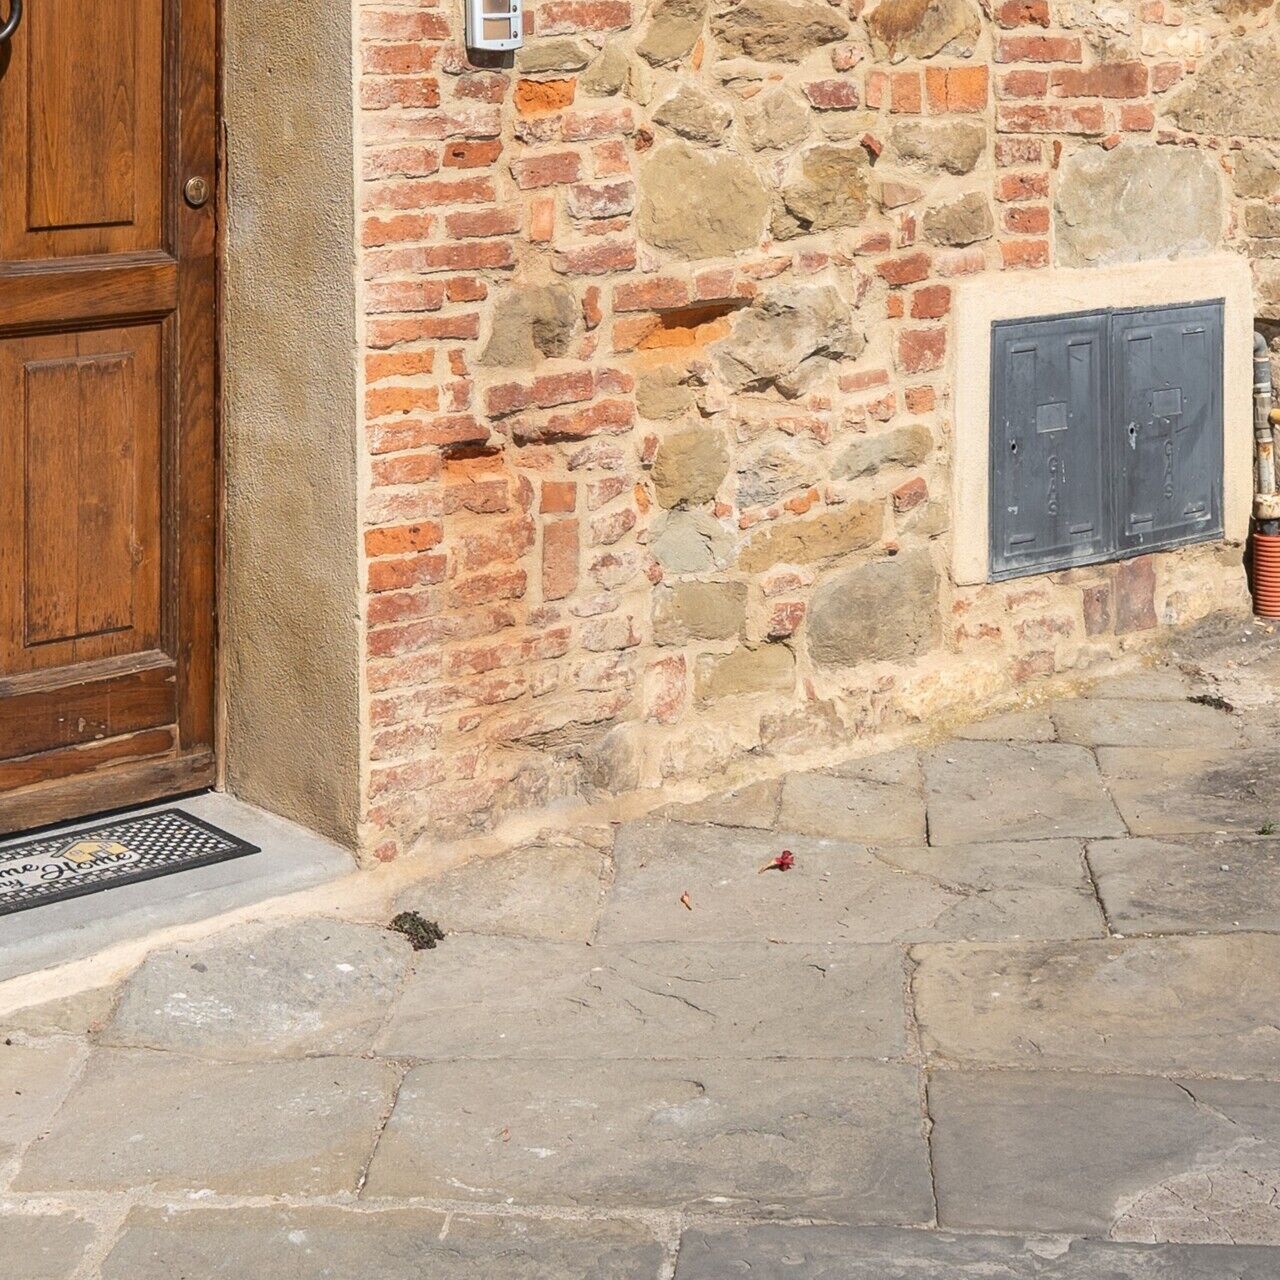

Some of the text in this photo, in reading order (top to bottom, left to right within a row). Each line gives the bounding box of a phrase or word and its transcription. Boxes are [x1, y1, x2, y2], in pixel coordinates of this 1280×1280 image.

[1047, 454, 1059, 516] GAS
[1164, 438, 1173, 500] GAS
[41, 852, 133, 879] Home
